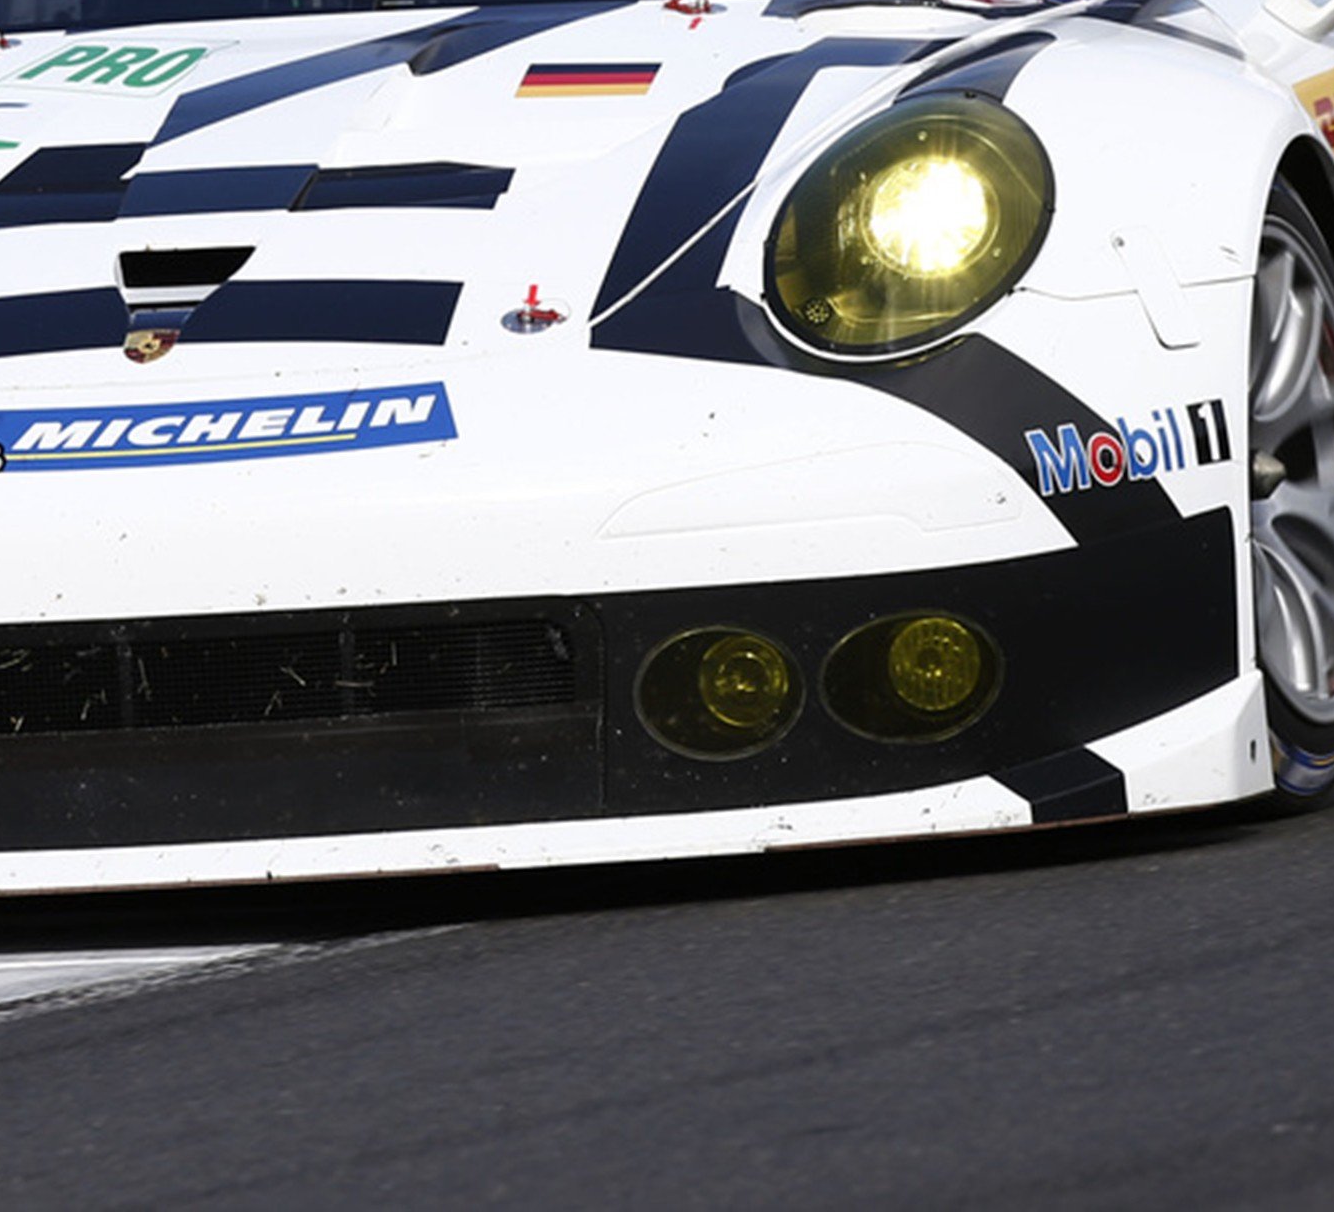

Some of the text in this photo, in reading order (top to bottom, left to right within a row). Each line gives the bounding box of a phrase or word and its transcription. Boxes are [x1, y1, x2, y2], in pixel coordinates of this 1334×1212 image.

[17, 45, 208, 88] PRO
[11, 394, 437, 451] MICHELIN
[1025, 401, 1227, 495] Mobil 1
